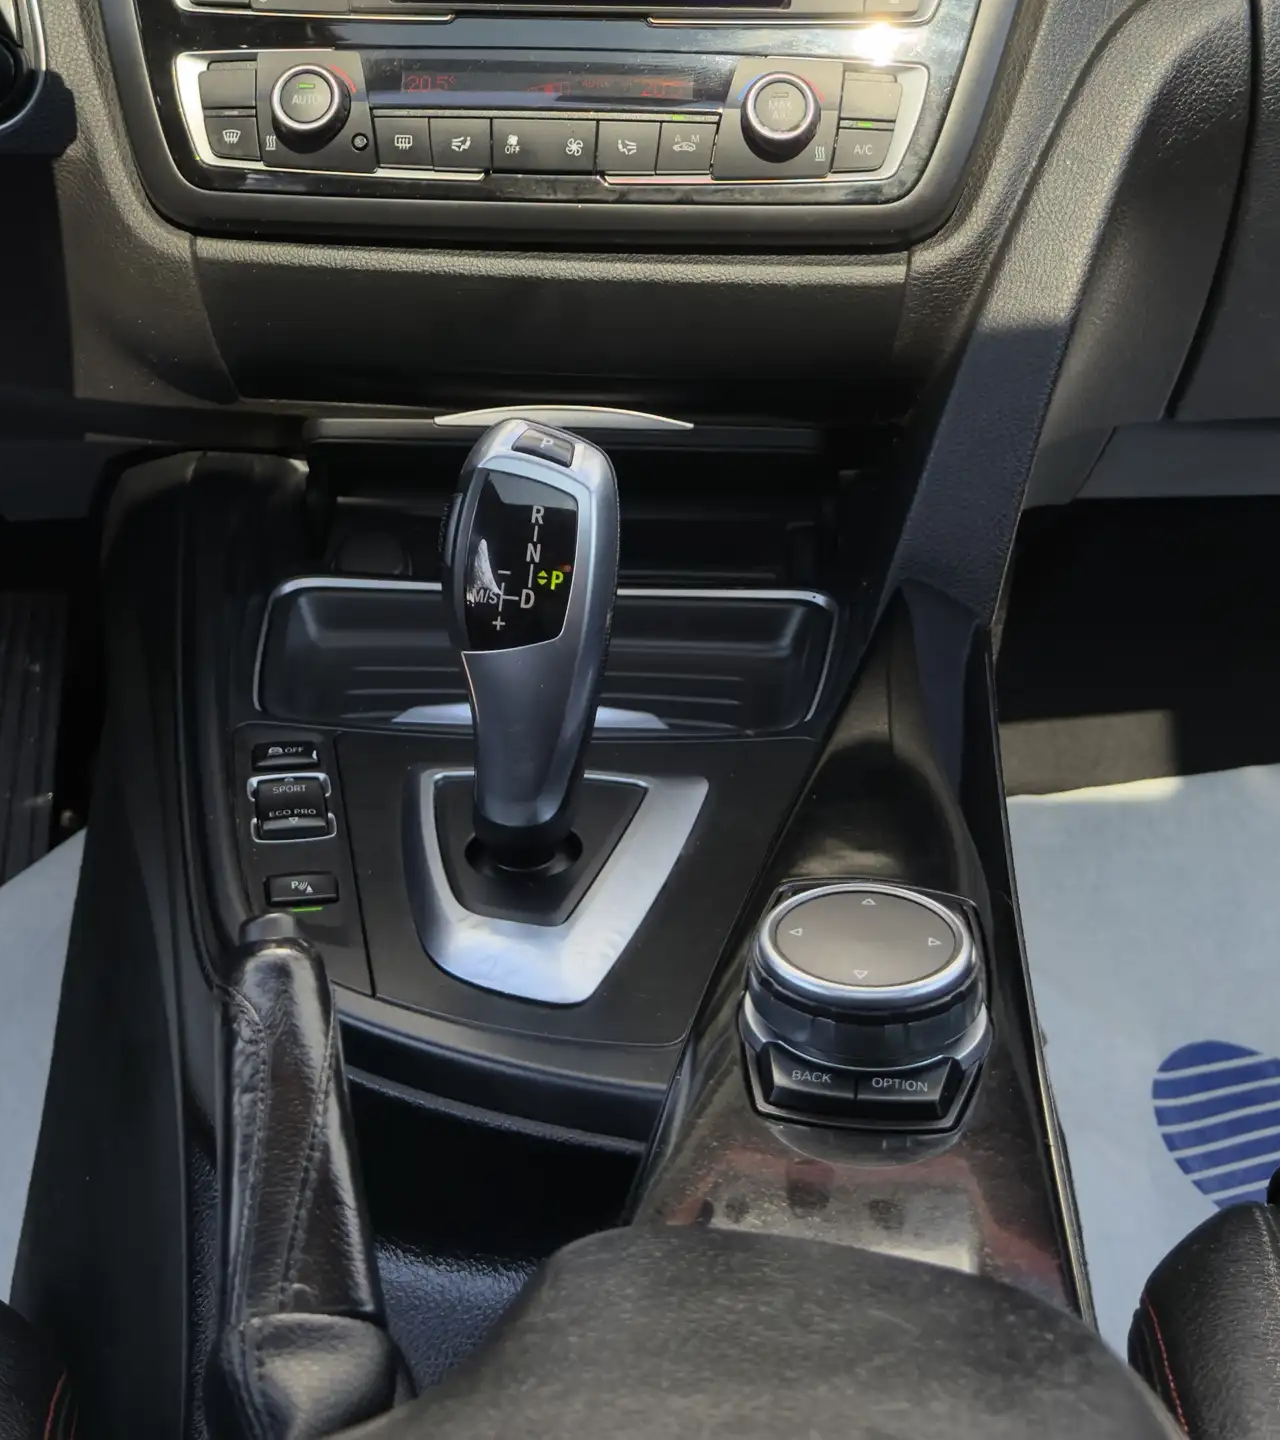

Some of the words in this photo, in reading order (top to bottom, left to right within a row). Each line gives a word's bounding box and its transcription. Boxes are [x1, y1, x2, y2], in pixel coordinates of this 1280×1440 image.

[291, 94, 319, 105] AUTO
[504, 144, 520, 155] OFF
[853, 144, 873, 155] A/C
[540, 437, 554, 449] P
[531, 505, 545, 525] R
[526, 543, 541, 563] N
[550, 570, 564, 590] P
[472, 589, 498, 604] M/S
[520, 589, 535, 609] D
[285, 746, 304, 754] OFF
[272, 784, 307, 794] SPORT
[269, 808, 291, 818] ECO
[293, 808, 317, 816] PRO
[791, 1070, 832, 1084] BACK
[872, 1077, 929, 1093] OPTION
